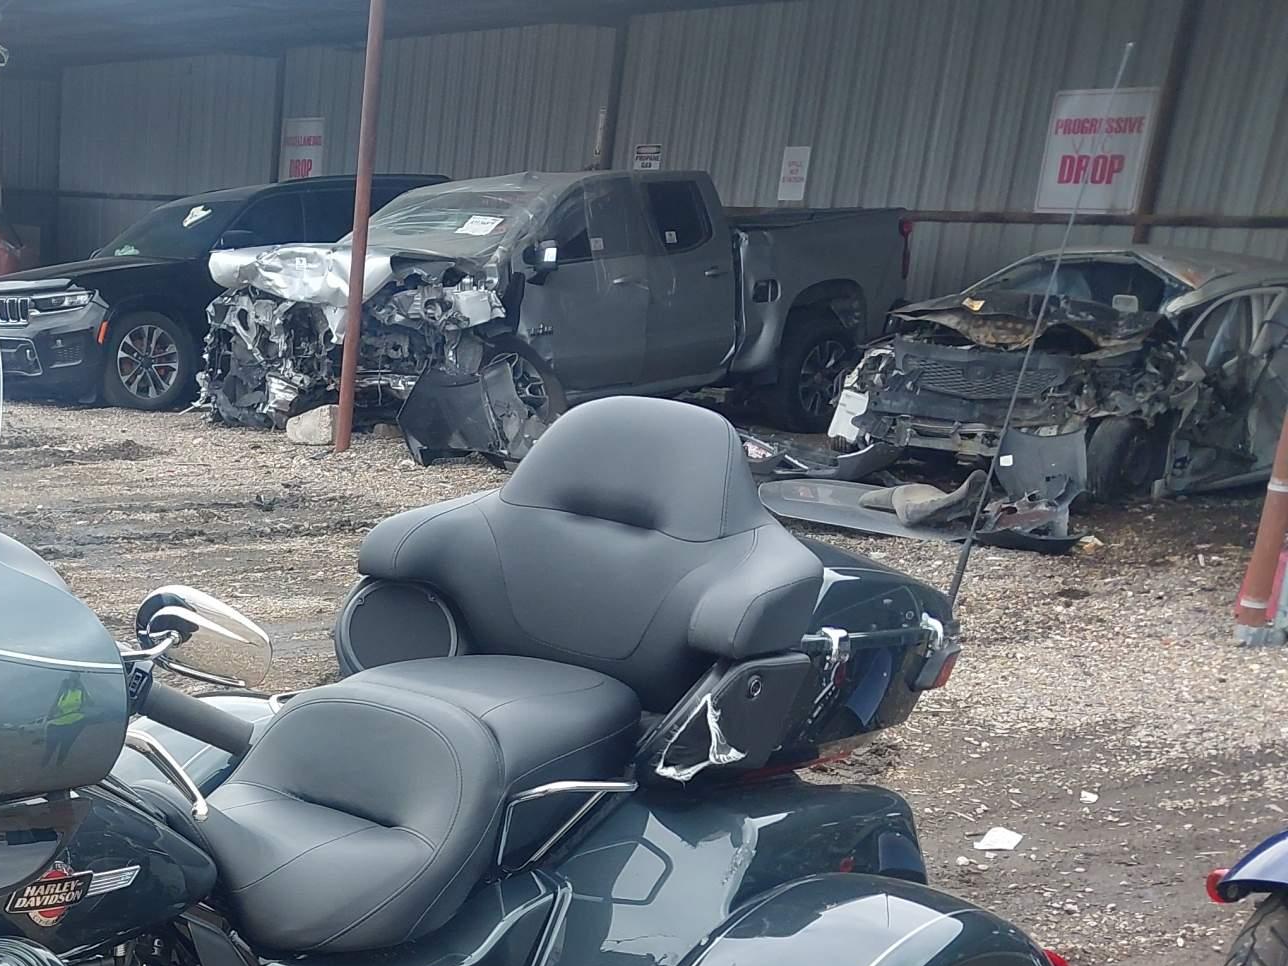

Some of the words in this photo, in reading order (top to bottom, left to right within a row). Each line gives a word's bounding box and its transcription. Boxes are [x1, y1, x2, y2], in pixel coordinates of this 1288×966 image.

[289, 158, 313, 178] DROP
[1057, 154, 1125, 184] DROP
[23, 879, 84, 898] HARLEY-
[14, 889, 83, 909] DAVIDSON
